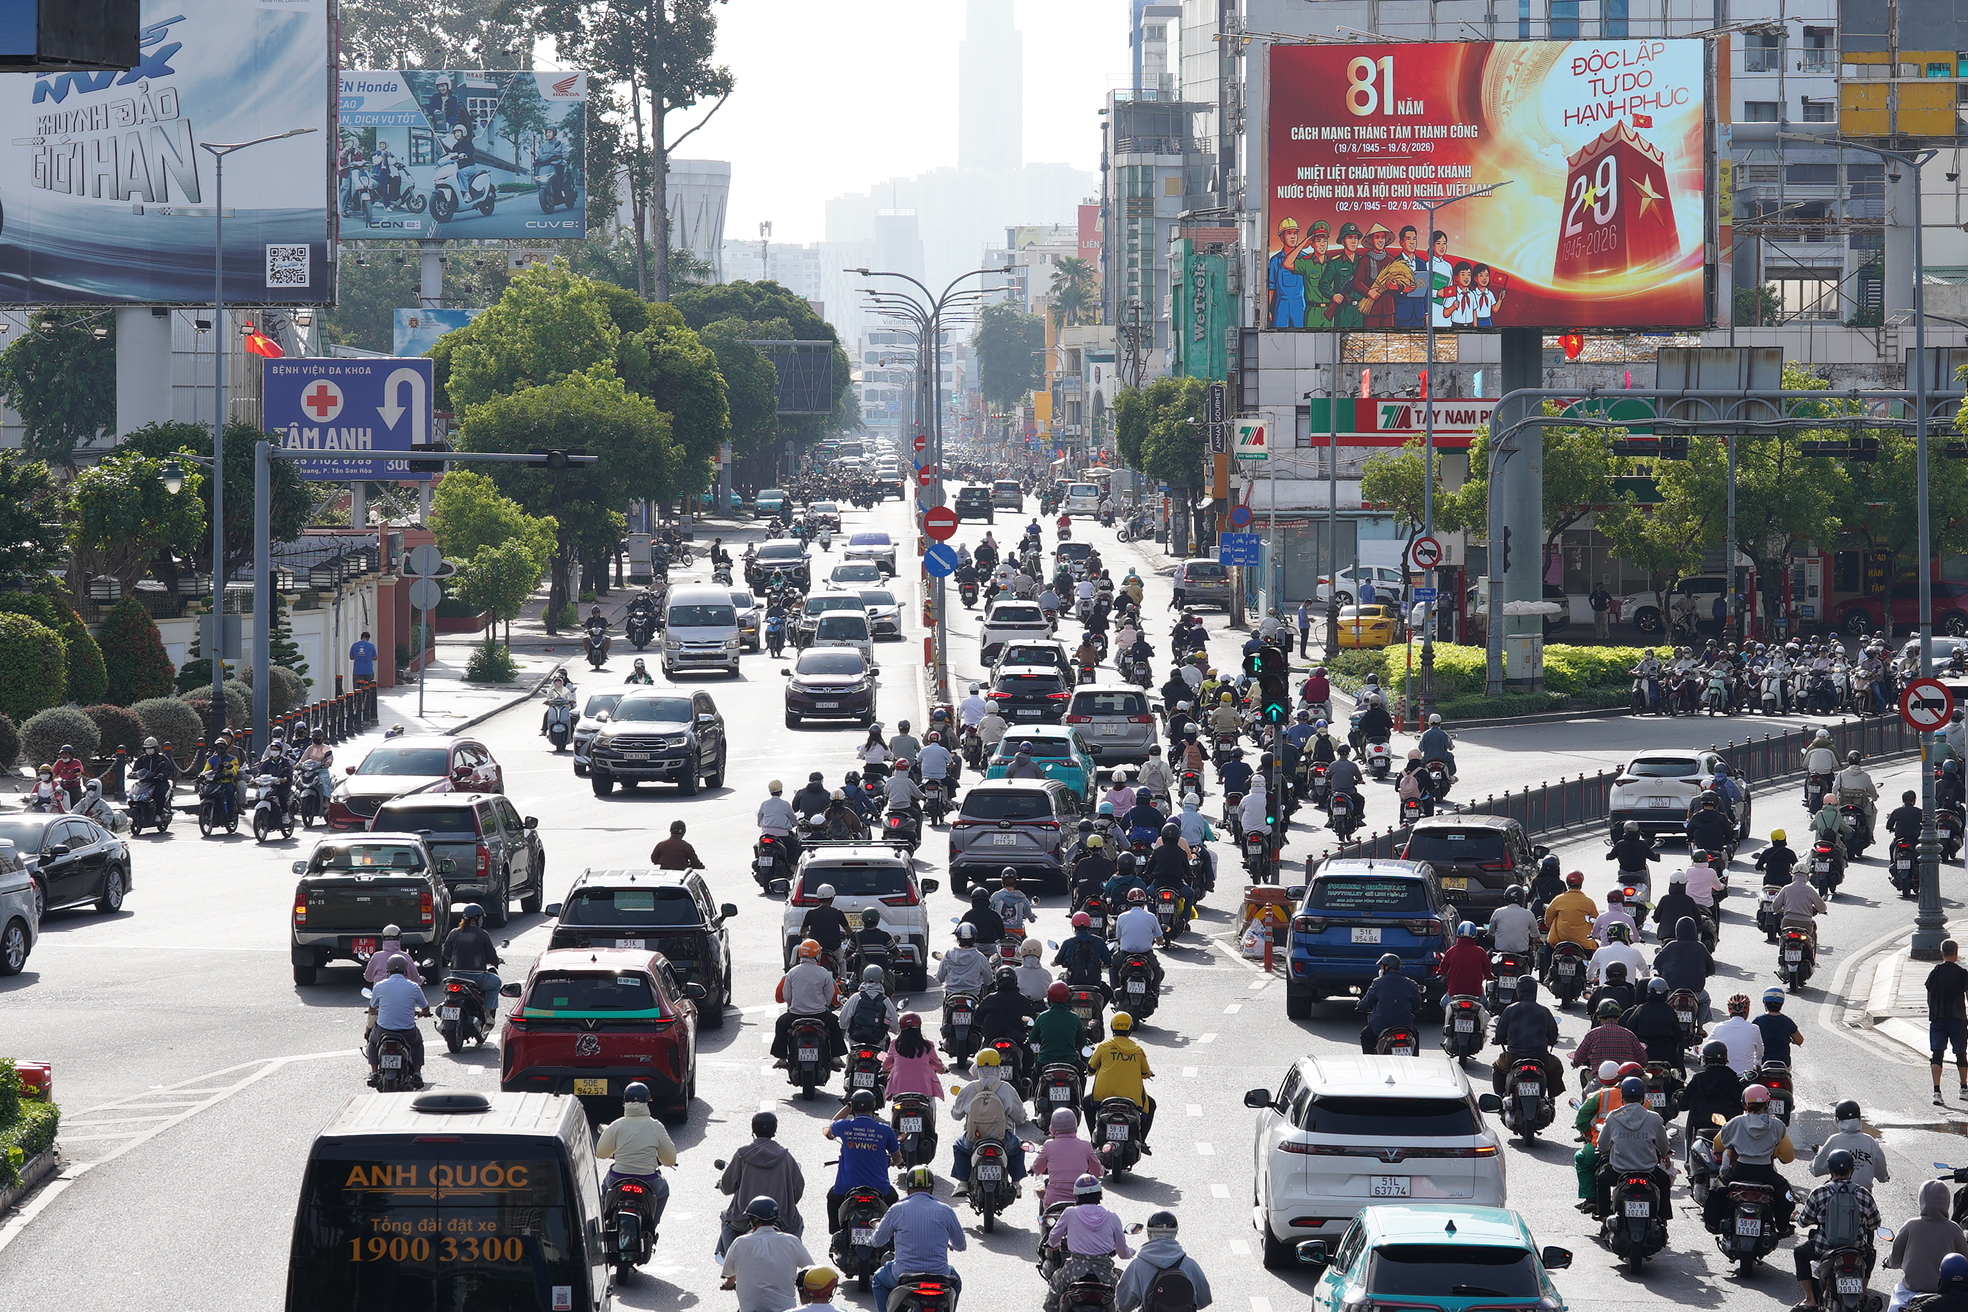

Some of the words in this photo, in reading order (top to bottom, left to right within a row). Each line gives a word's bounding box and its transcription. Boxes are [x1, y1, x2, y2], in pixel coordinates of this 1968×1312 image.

[1571, 49, 1619, 76] ĐỘC
[1623, 40, 1666, 67] LẬP
[357, 81, 398, 92] Honda
[1346, 56, 1394, 116] 81
[1397, 97, 1424, 115] NĂM
[1588, 74, 1620, 98] TỰ
[1622, 69, 1653, 92] DO
[36, 103, 108, 136] KHUYNH
[110, 82, 179, 127] ĐẢO
[1564, 97, 1627, 127] HẠNH
[1629, 84, 1690, 115] PHÚC
[355, 115, 379, 126] DỊCH
[381, 115, 395, 126] VỤ
[397, 112, 416, 124] TỐT
[1291, 124, 1319, 140] CÁCH
[1321, 126, 1351, 142] MẠNG
[1353, 123, 1387, 139] THÁNG
[1389, 123, 1412, 139] TÁM
[1414, 123, 1447, 138] THÀNH
[1450, 122, 1478, 138] CÔNG
[1334, 143, 1380, 154] (19/8/1945
[1387, 142, 1434, 153] 19/8/2026)
[31, 134, 84, 197] GIỚI
[1297, 164, 1325, 183] NHIỆT
[1326, 164, 1346, 182] LIỆT
[1348, 164, 1375, 179] CHÀO
[1376, 163, 1406, 181] MỪNG
[1408, 162, 1435, 179] QUỐC
[1437, 163, 1472, 178] KHÁNH
[1277, 182, 1304, 199] NƯỚC
[1306, 183, 1332, 201] CỘNG
[1334, 184, 1355, 198] HÒA
[1356, 182, 1370, 198] XÃ
[1372, 183, 1389, 200] HỘI
[1391, 182, 1412, 198] CHỦ
[1413, 181, 1443, 197] NGHĨA
[1445, 182, 1467, 199] VIỆT
[1469, 184, 1492, 197] NAM
[1335, 201, 1381, 212] (02/9/1945
[525, 221, 560, 229] CUV
[1082, 239, 1100, 248] LIÊN
[1562, 224, 1617, 262] 1945-2026
[1193, 261, 1208, 343] WeTrek
[272, 365, 299, 377] BỆNH
[302, 365, 325, 377] VIỆN
[329, 366, 342, 375] ĐA
[345, 366, 372, 375] KHOA
[1445, 410, 1476, 424] NAM
[273, 422, 319, 450] TÂM
[325, 428, 372, 450] ANH
[577, 1087, 604, 1095] 942.52
[583, 1079, 598, 1087] 50E
[855, 1143, 877, 1151] VNVC
[345, 1166, 417, 1187] ANH
[428, 1161, 529, 1189] QUỐC
[1381, 1177, 1399, 1186] 51L
[1374, 1186, 1406, 1196] 637.74
[370, 1216, 412, 1235] Tổng
[417, 1218, 442, 1233] đài
[447, 1218, 473, 1235] đặt
[478, 1221, 497, 1232] xe
[1738, 1227, 1759, 1235] 129.00
[349, 1237, 430, 1262] 1900
[439, 1237, 523, 1262] 3300
[1838, 1285, 1862, 1293] 309.32
